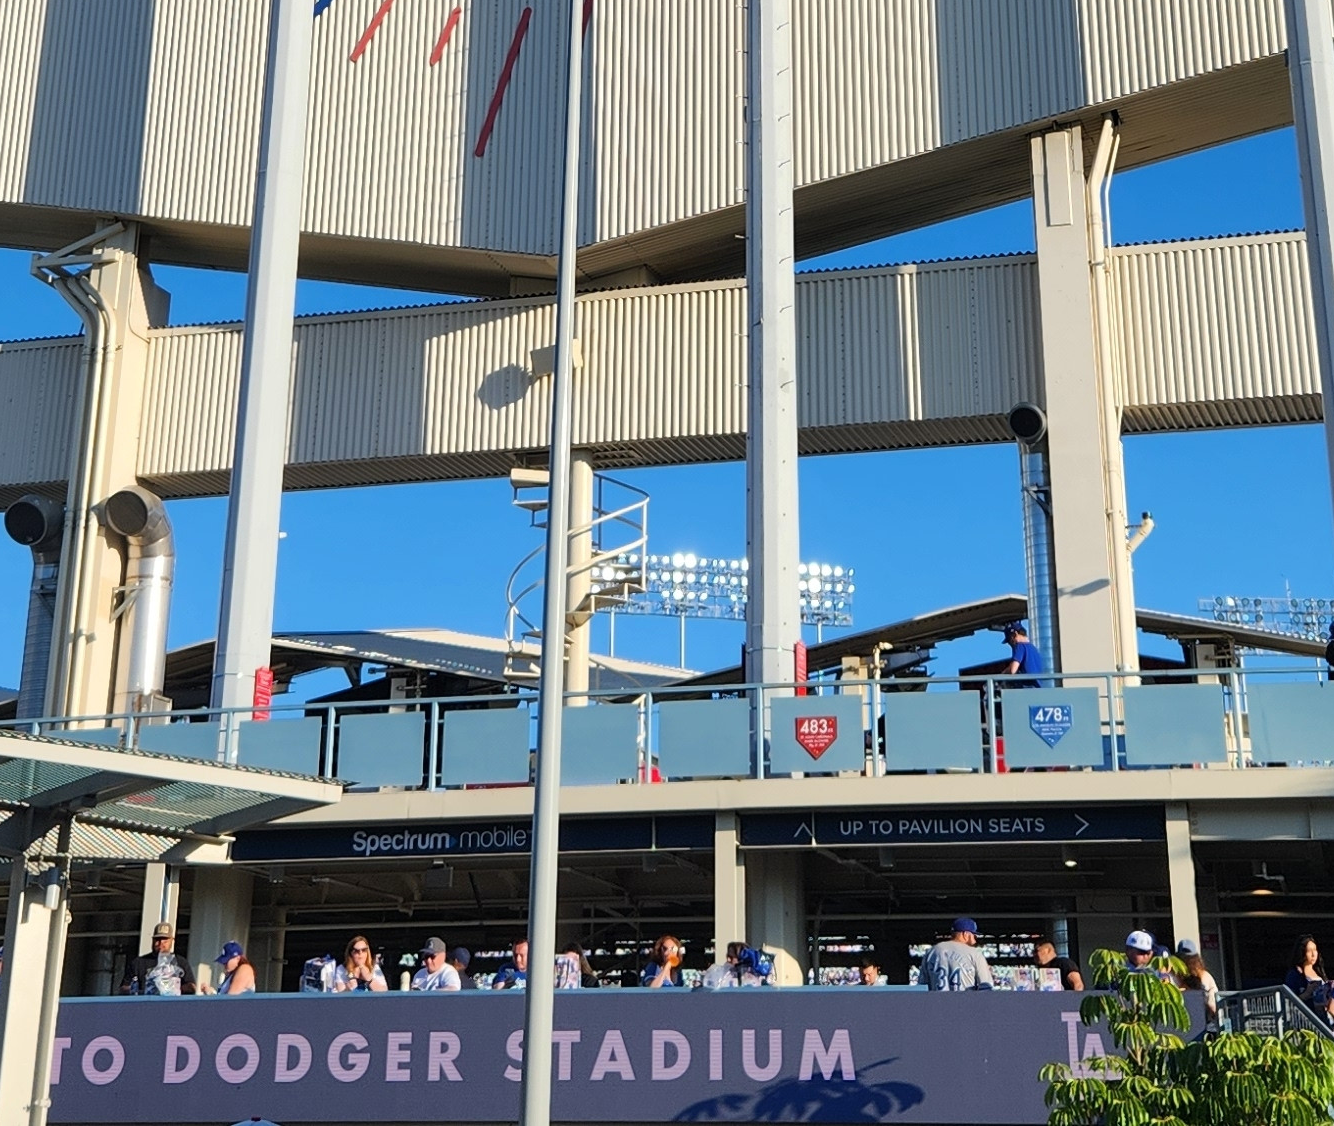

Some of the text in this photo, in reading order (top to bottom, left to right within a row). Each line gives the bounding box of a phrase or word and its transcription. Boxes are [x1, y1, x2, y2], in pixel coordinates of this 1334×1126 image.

[1034, 707, 1062, 722] 478
[800, 718, 827, 734] 483
[840, 817, 1045, 835] UP TO PAVILION SEATS
[352, 825, 527, 856] Spectrum mobile
[937, 966, 962, 991] 34
[162, 1030, 464, 1084] DODGER
[503, 1028, 857, 1082] STADIUM
